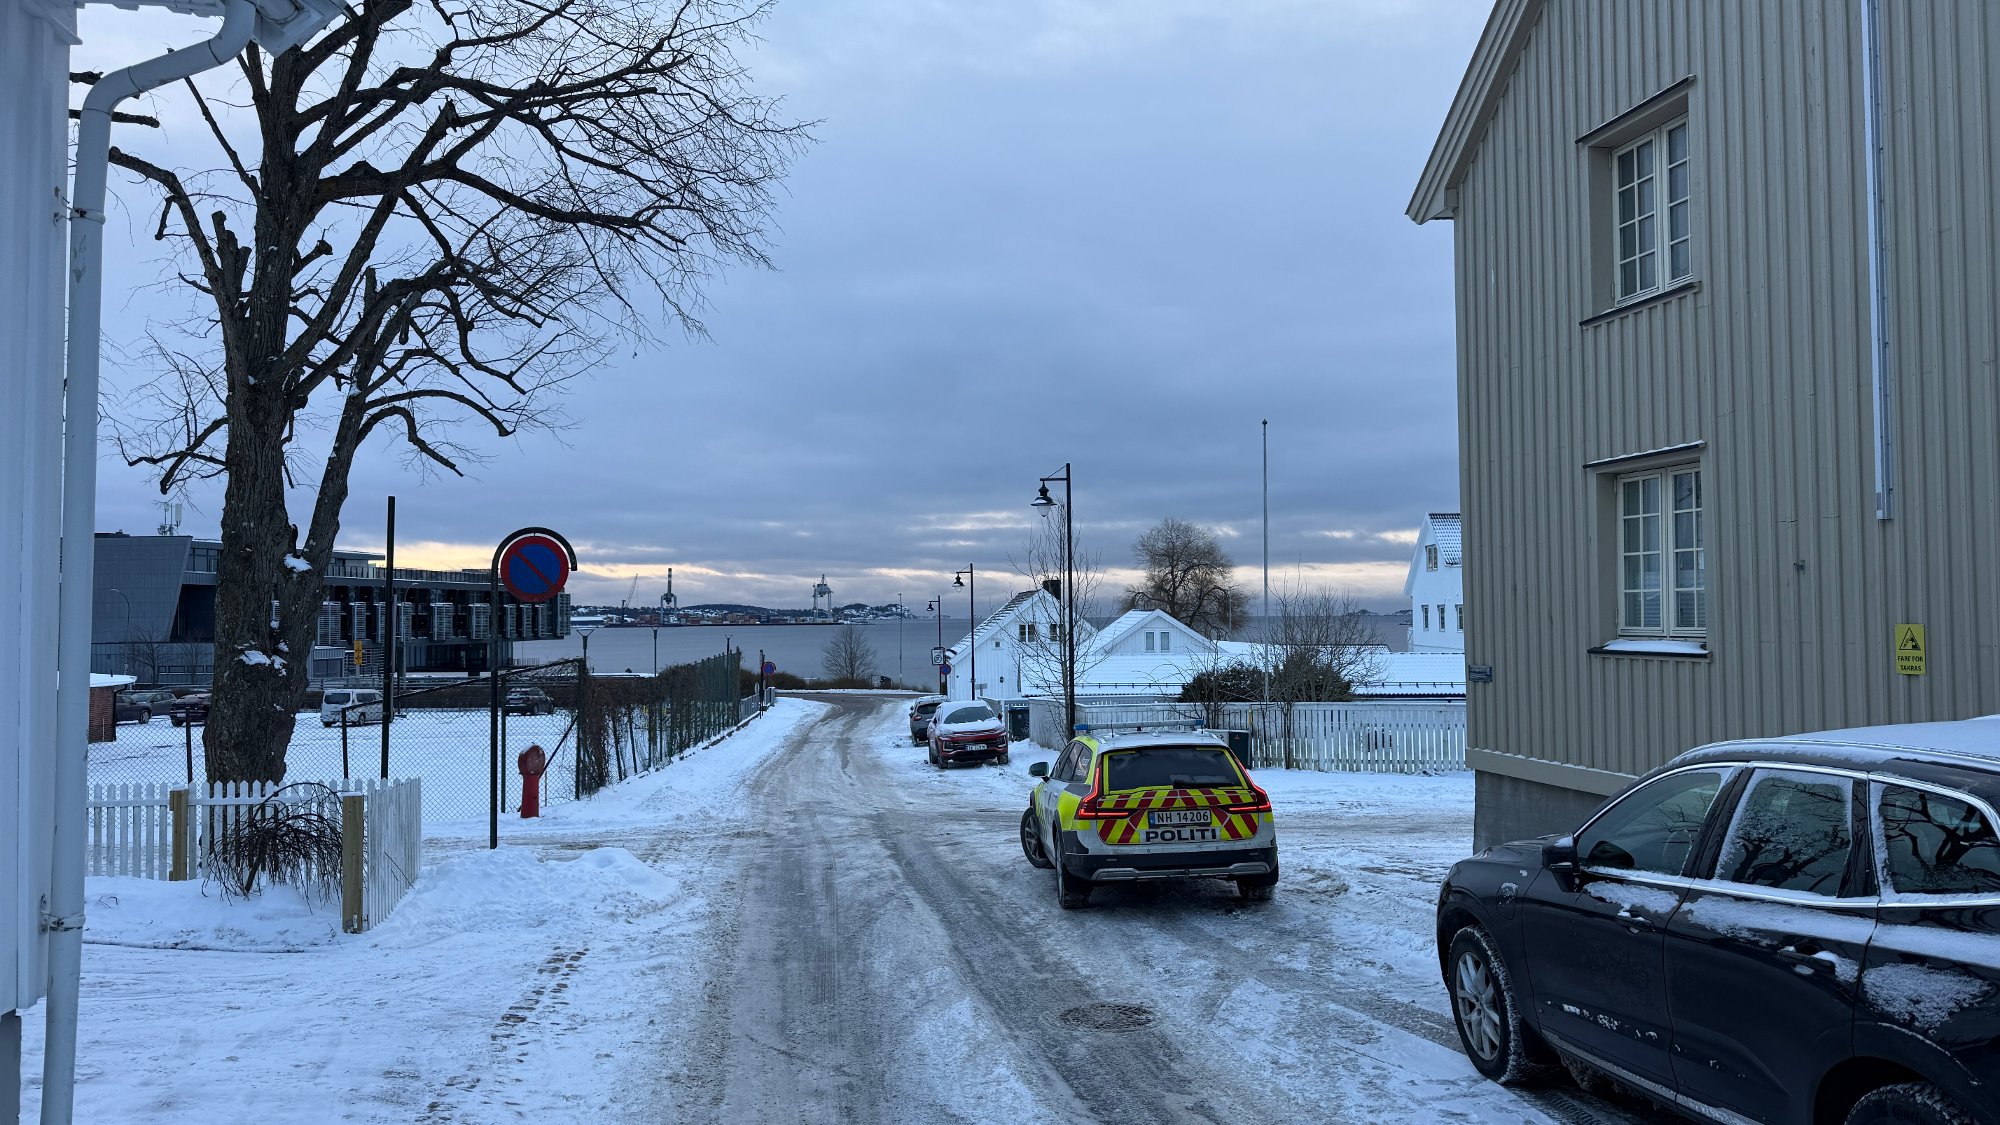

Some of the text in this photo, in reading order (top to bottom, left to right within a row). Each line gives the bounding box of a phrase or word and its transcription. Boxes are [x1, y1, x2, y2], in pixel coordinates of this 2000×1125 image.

[1157, 812, 1209, 823] NH 14206
[1146, 828, 1216, 842] POLITI
